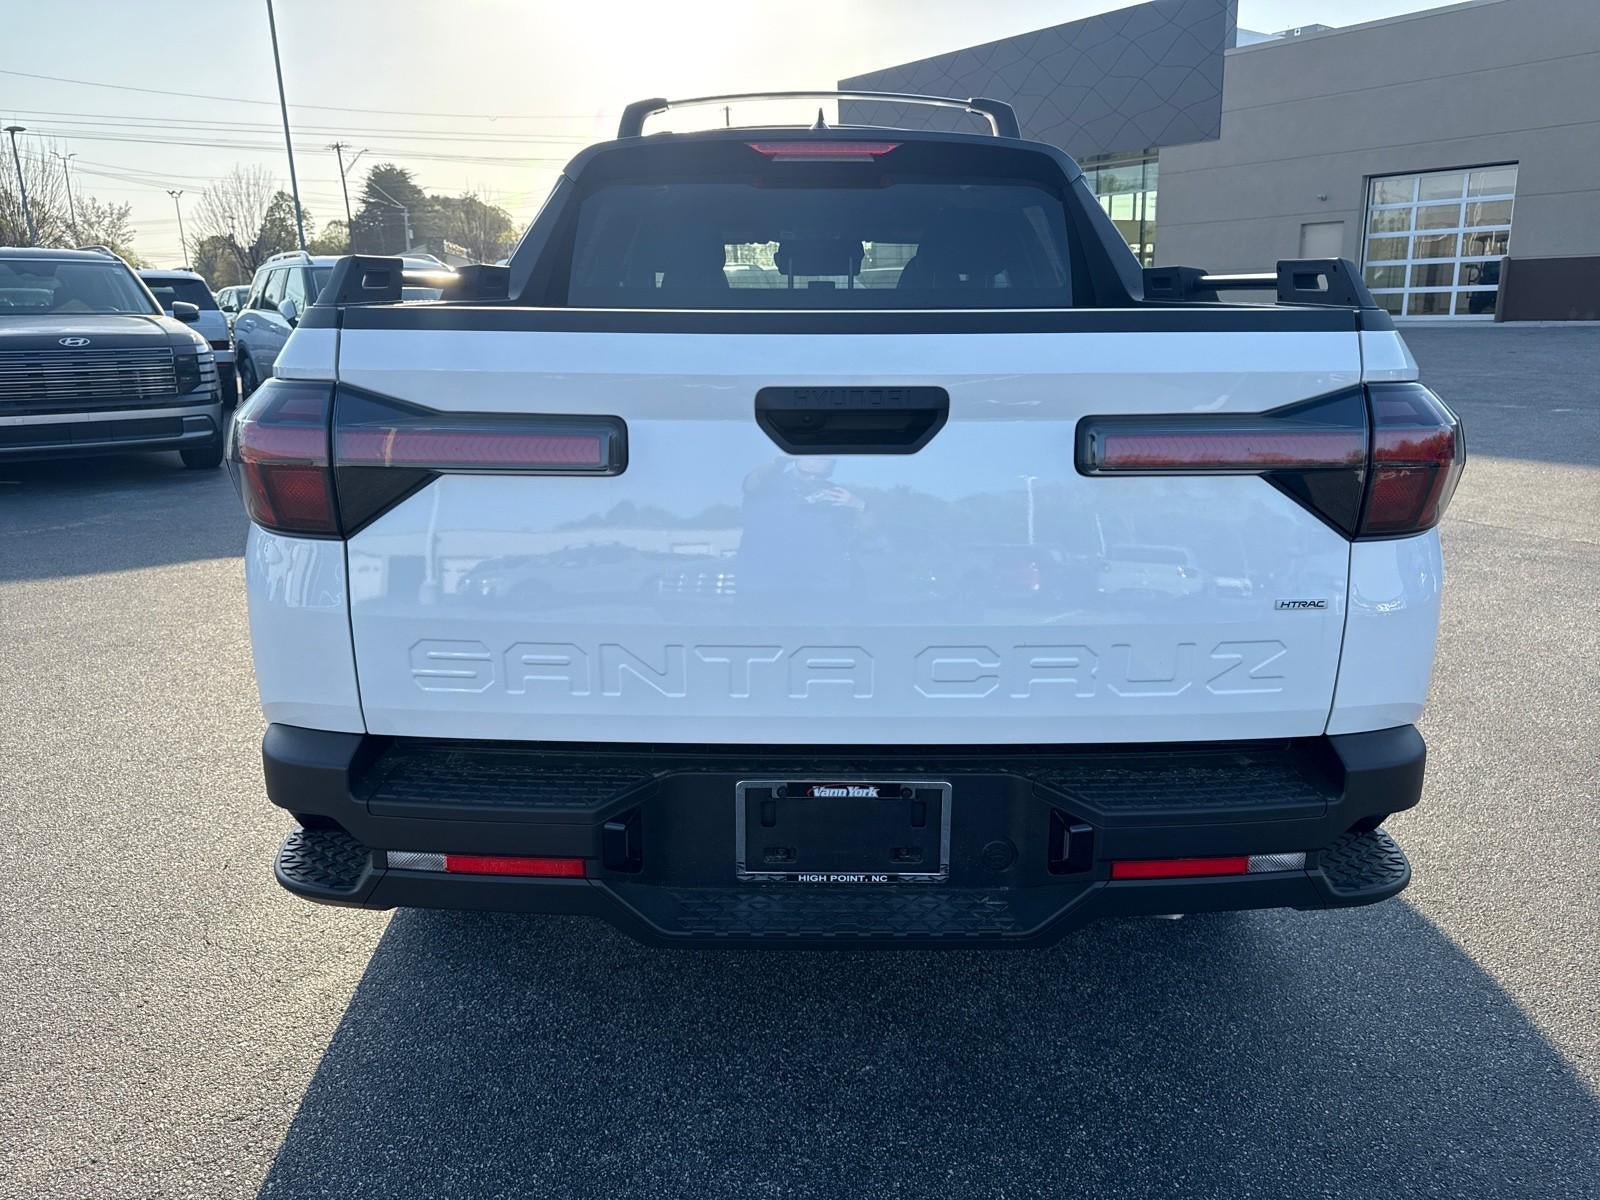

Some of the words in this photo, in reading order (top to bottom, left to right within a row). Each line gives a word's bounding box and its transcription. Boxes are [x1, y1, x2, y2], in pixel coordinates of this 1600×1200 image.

[1280, 600, 1325, 608] HTRAC
[408, 638, 876, 699] SANTA
[914, 640, 1288, 699] CRUZ
[798, 874, 827, 882] HIGH
[830, 875, 868, 883] POINT,
